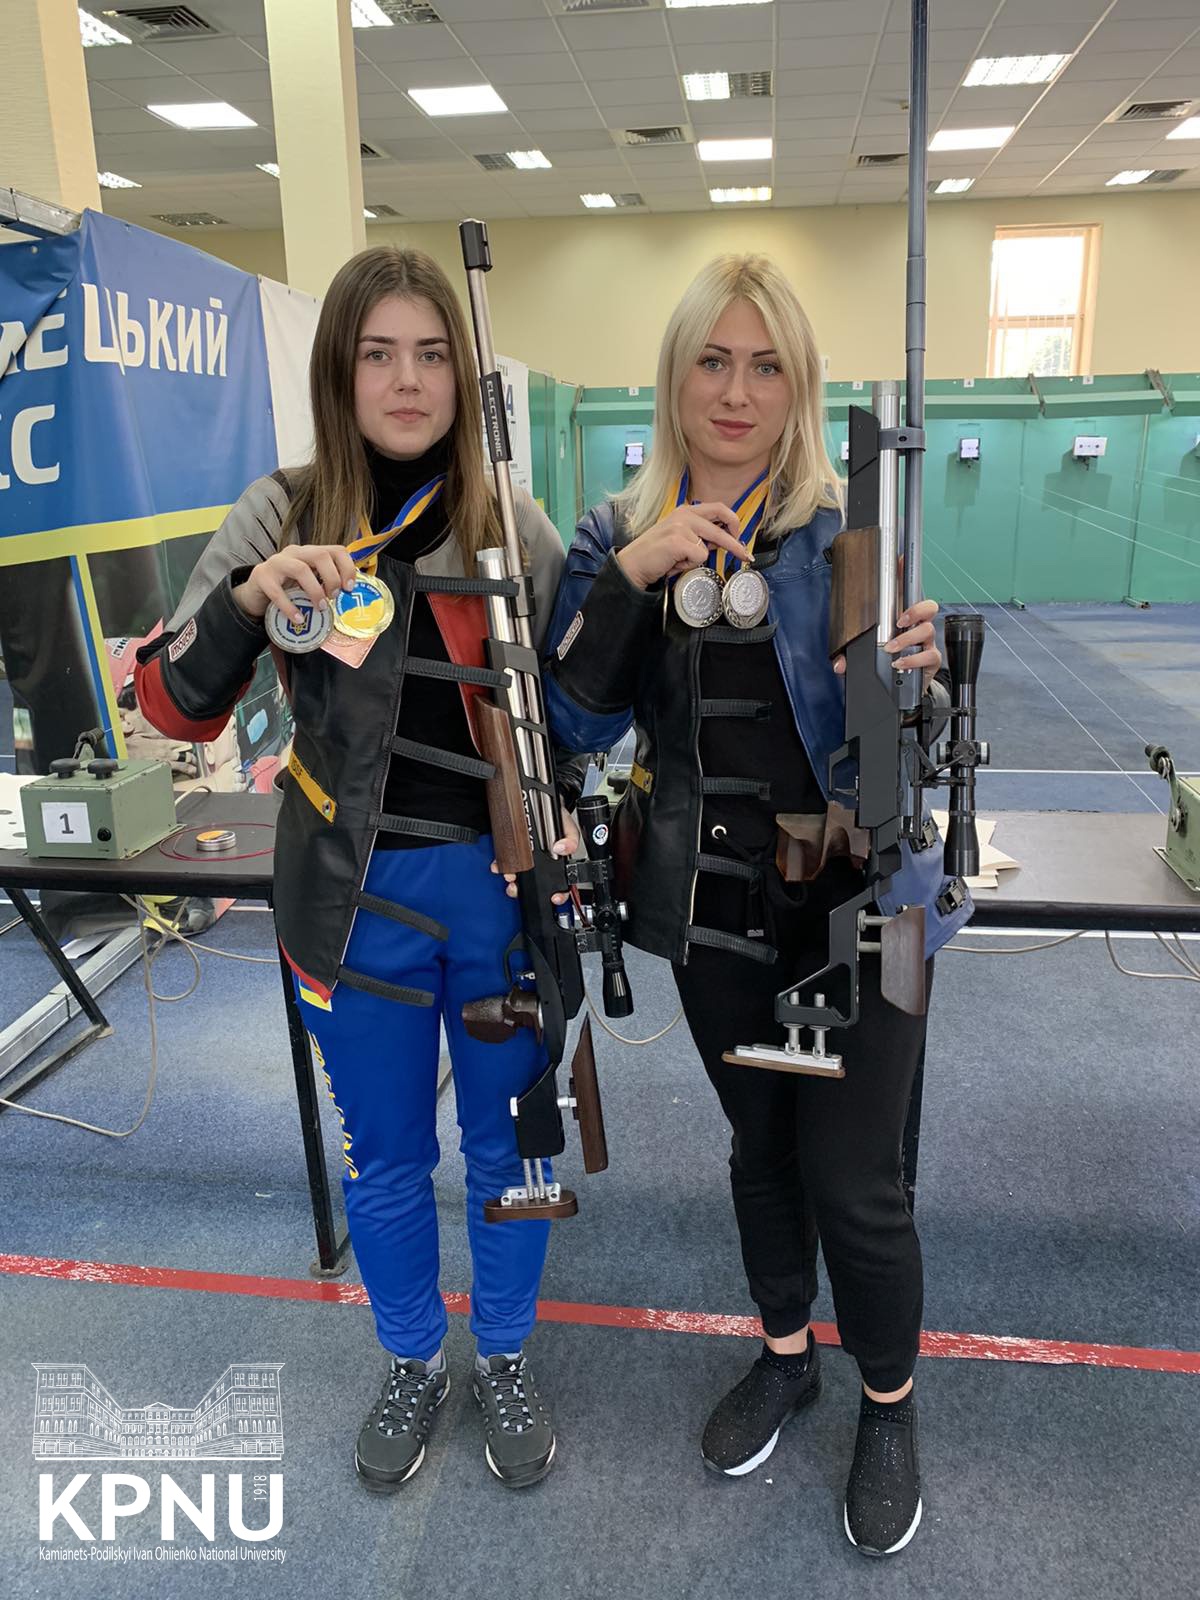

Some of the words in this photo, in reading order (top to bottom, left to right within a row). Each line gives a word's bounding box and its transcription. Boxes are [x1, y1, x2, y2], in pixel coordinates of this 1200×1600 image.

[0, 404, 60, 490] С
[486, 380, 503, 458] ELECTRONIC
[59, 812, 75, 835] 1
